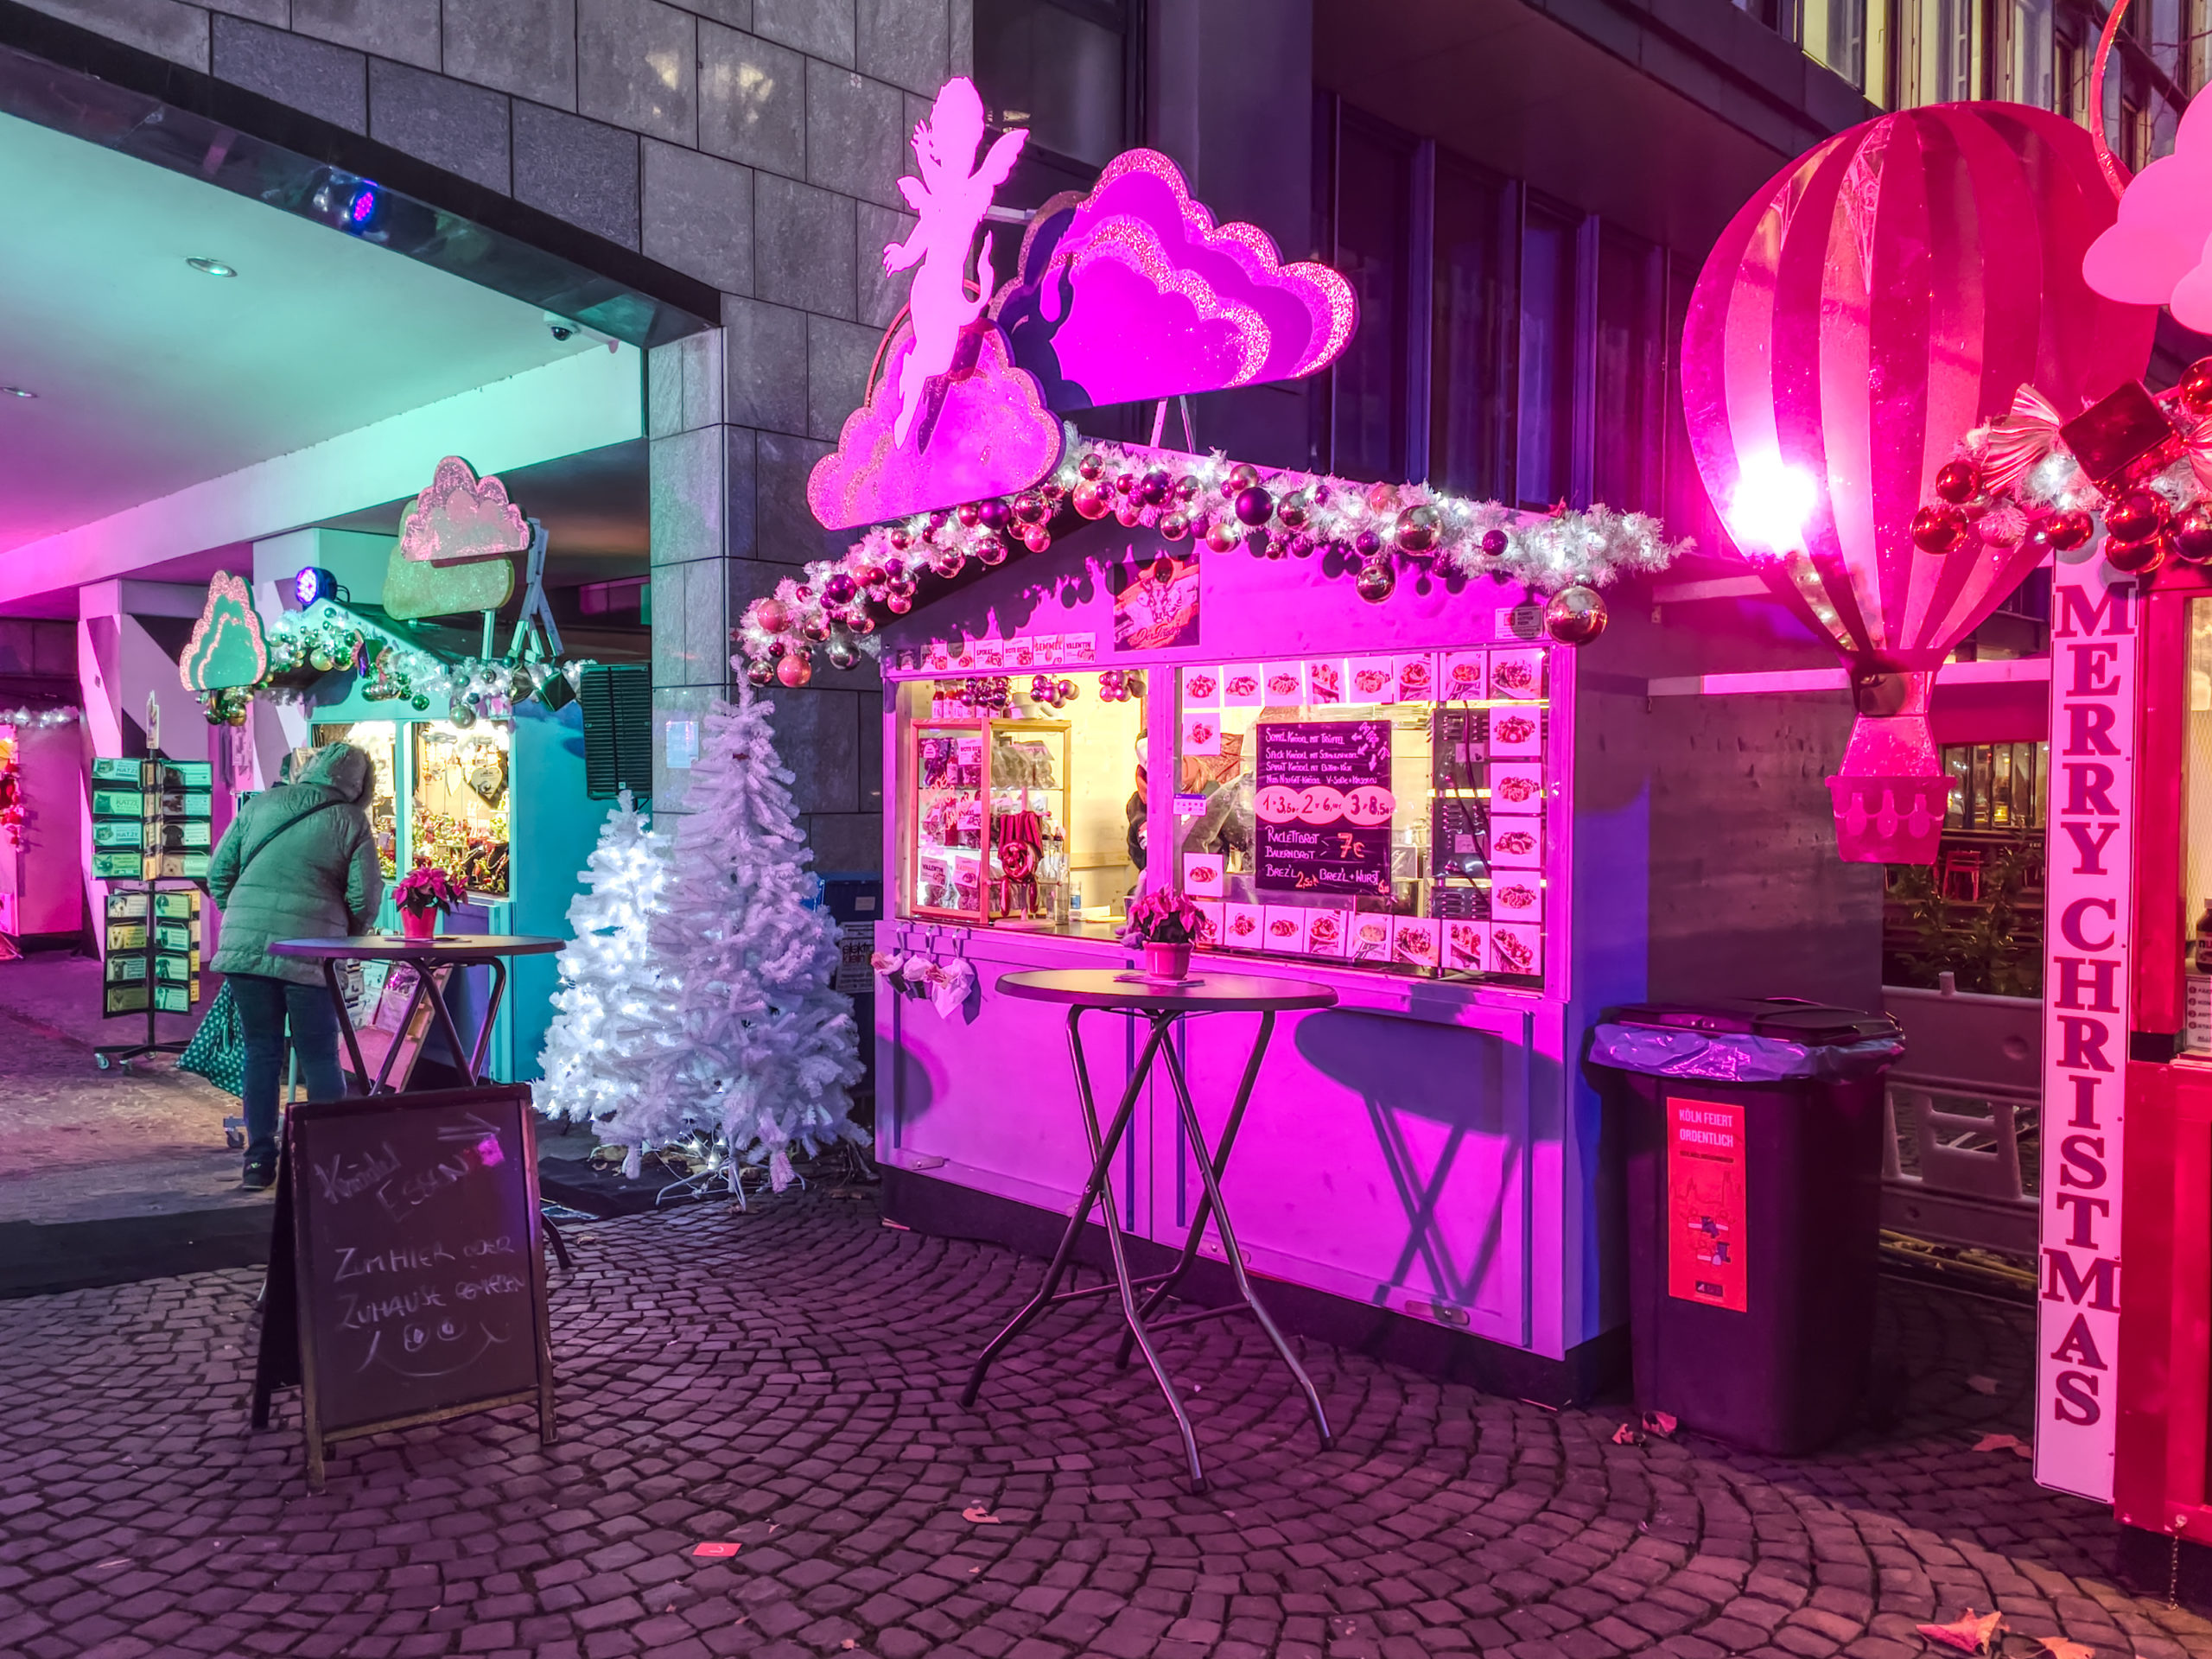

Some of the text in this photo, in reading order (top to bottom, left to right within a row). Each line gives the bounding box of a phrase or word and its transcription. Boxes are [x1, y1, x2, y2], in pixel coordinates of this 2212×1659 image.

[2042, 582, 2135, 1426] MERRY CHRISTMAS
[1679, 1108, 1732, 1128] KÖLN FEIERT
[1680, 1128, 1733, 1147] ORDENTLICH
